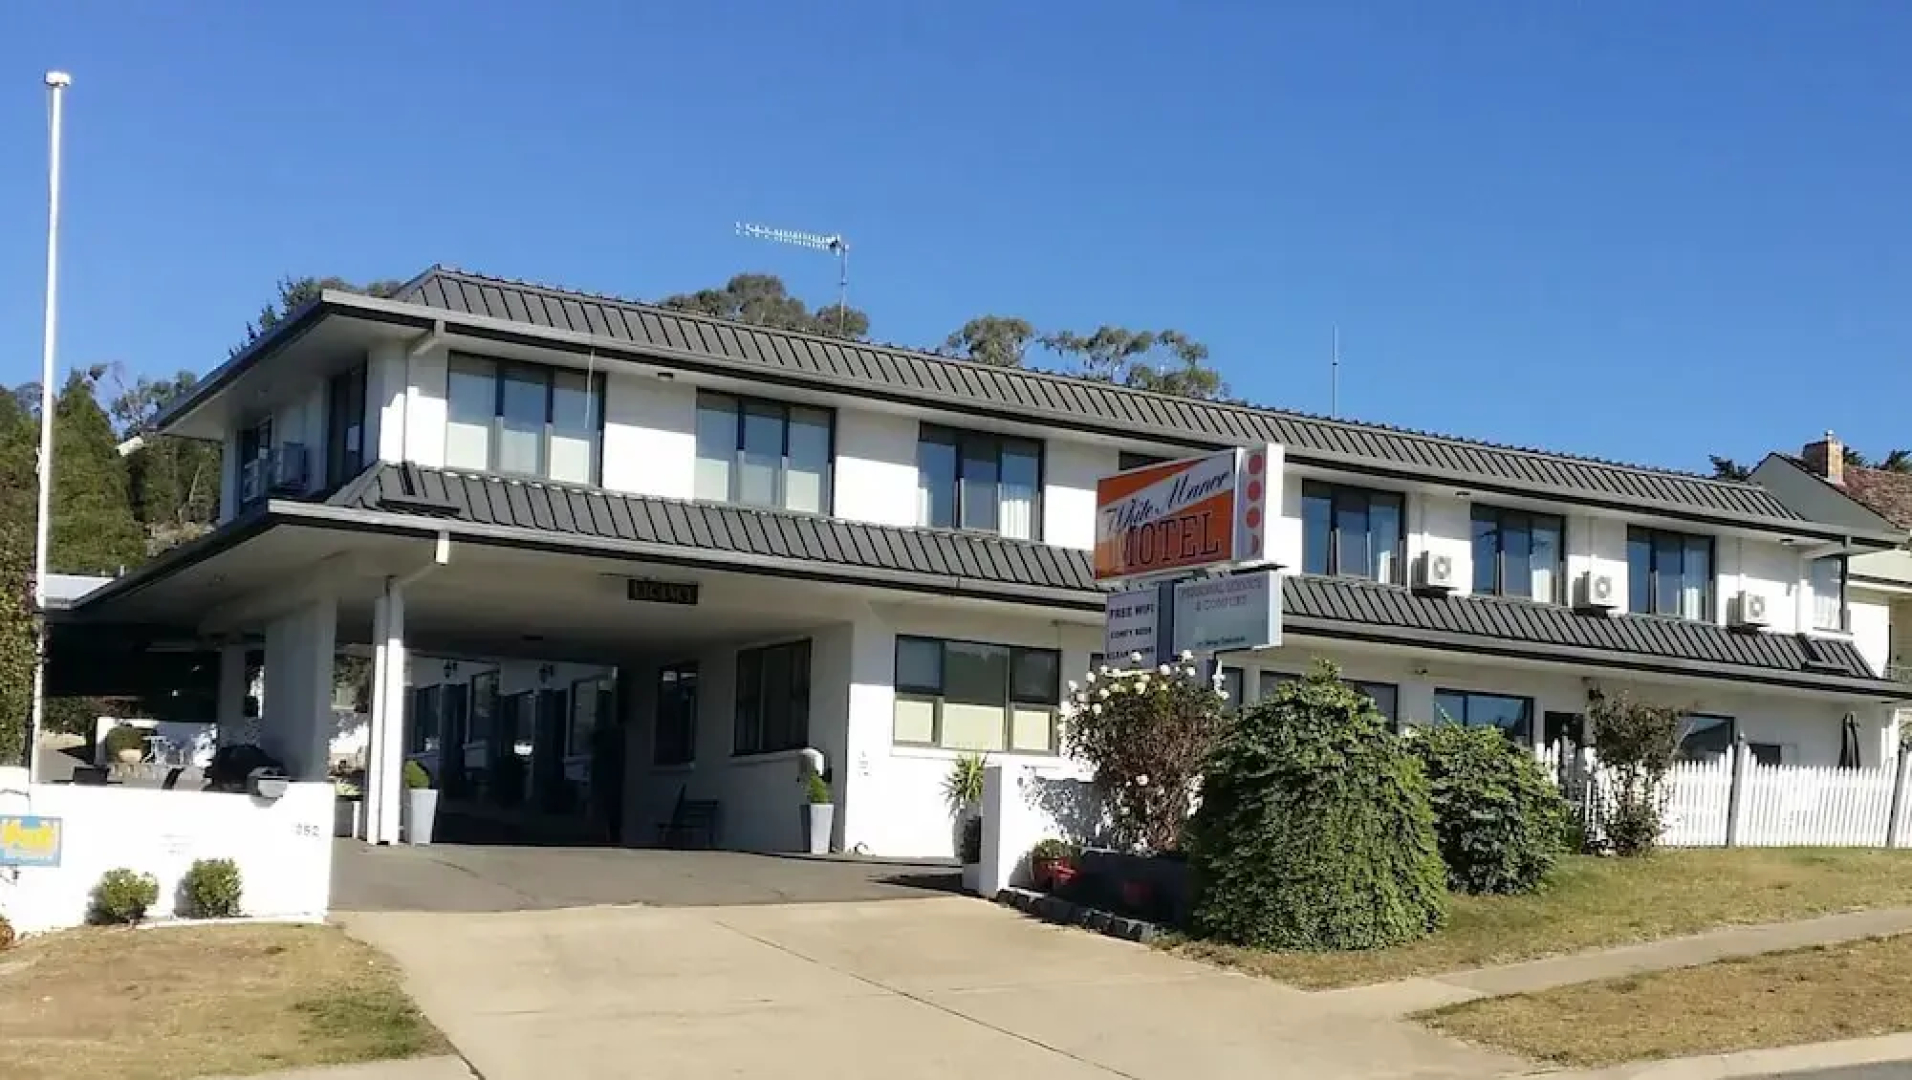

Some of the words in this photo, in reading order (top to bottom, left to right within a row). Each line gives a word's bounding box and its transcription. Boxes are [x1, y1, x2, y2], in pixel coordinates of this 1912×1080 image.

[1104, 497, 1157, 535] White
[1168, 471, 1231, 509] Manor
[1112, 511, 1219, 567] MOTEL
[1109, 606, 1133, 620] FREE
[1135, 603, 1155, 617] WIFI
